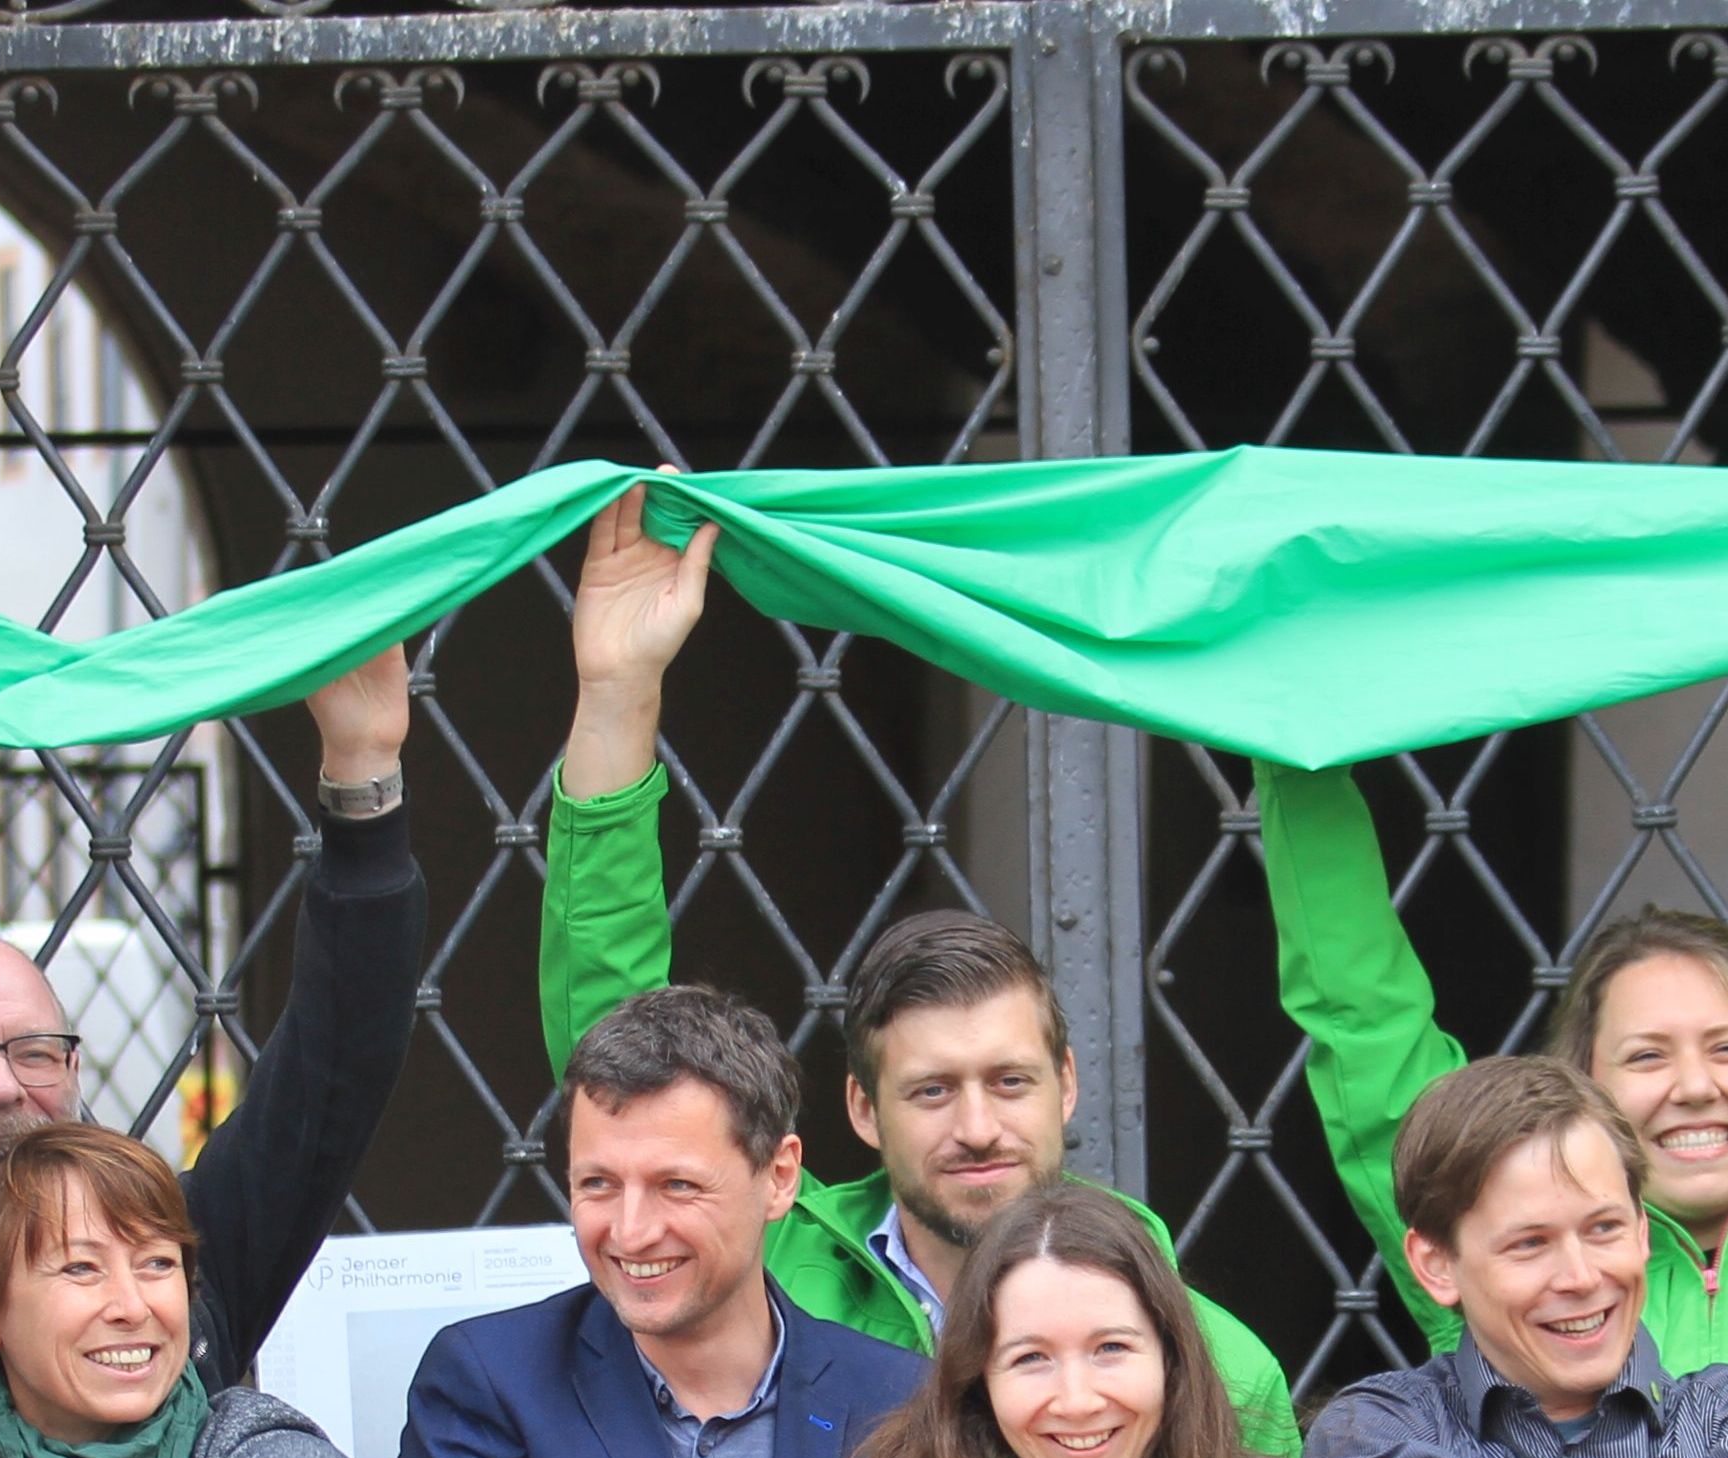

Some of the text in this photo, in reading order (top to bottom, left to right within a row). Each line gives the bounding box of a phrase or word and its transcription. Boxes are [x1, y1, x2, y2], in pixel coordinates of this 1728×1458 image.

[342, 1257, 408, 1272] Jenaer
[483, 1255, 553, 1269] 2018.2019
[342, 1268, 462, 1288] Philharmonie
